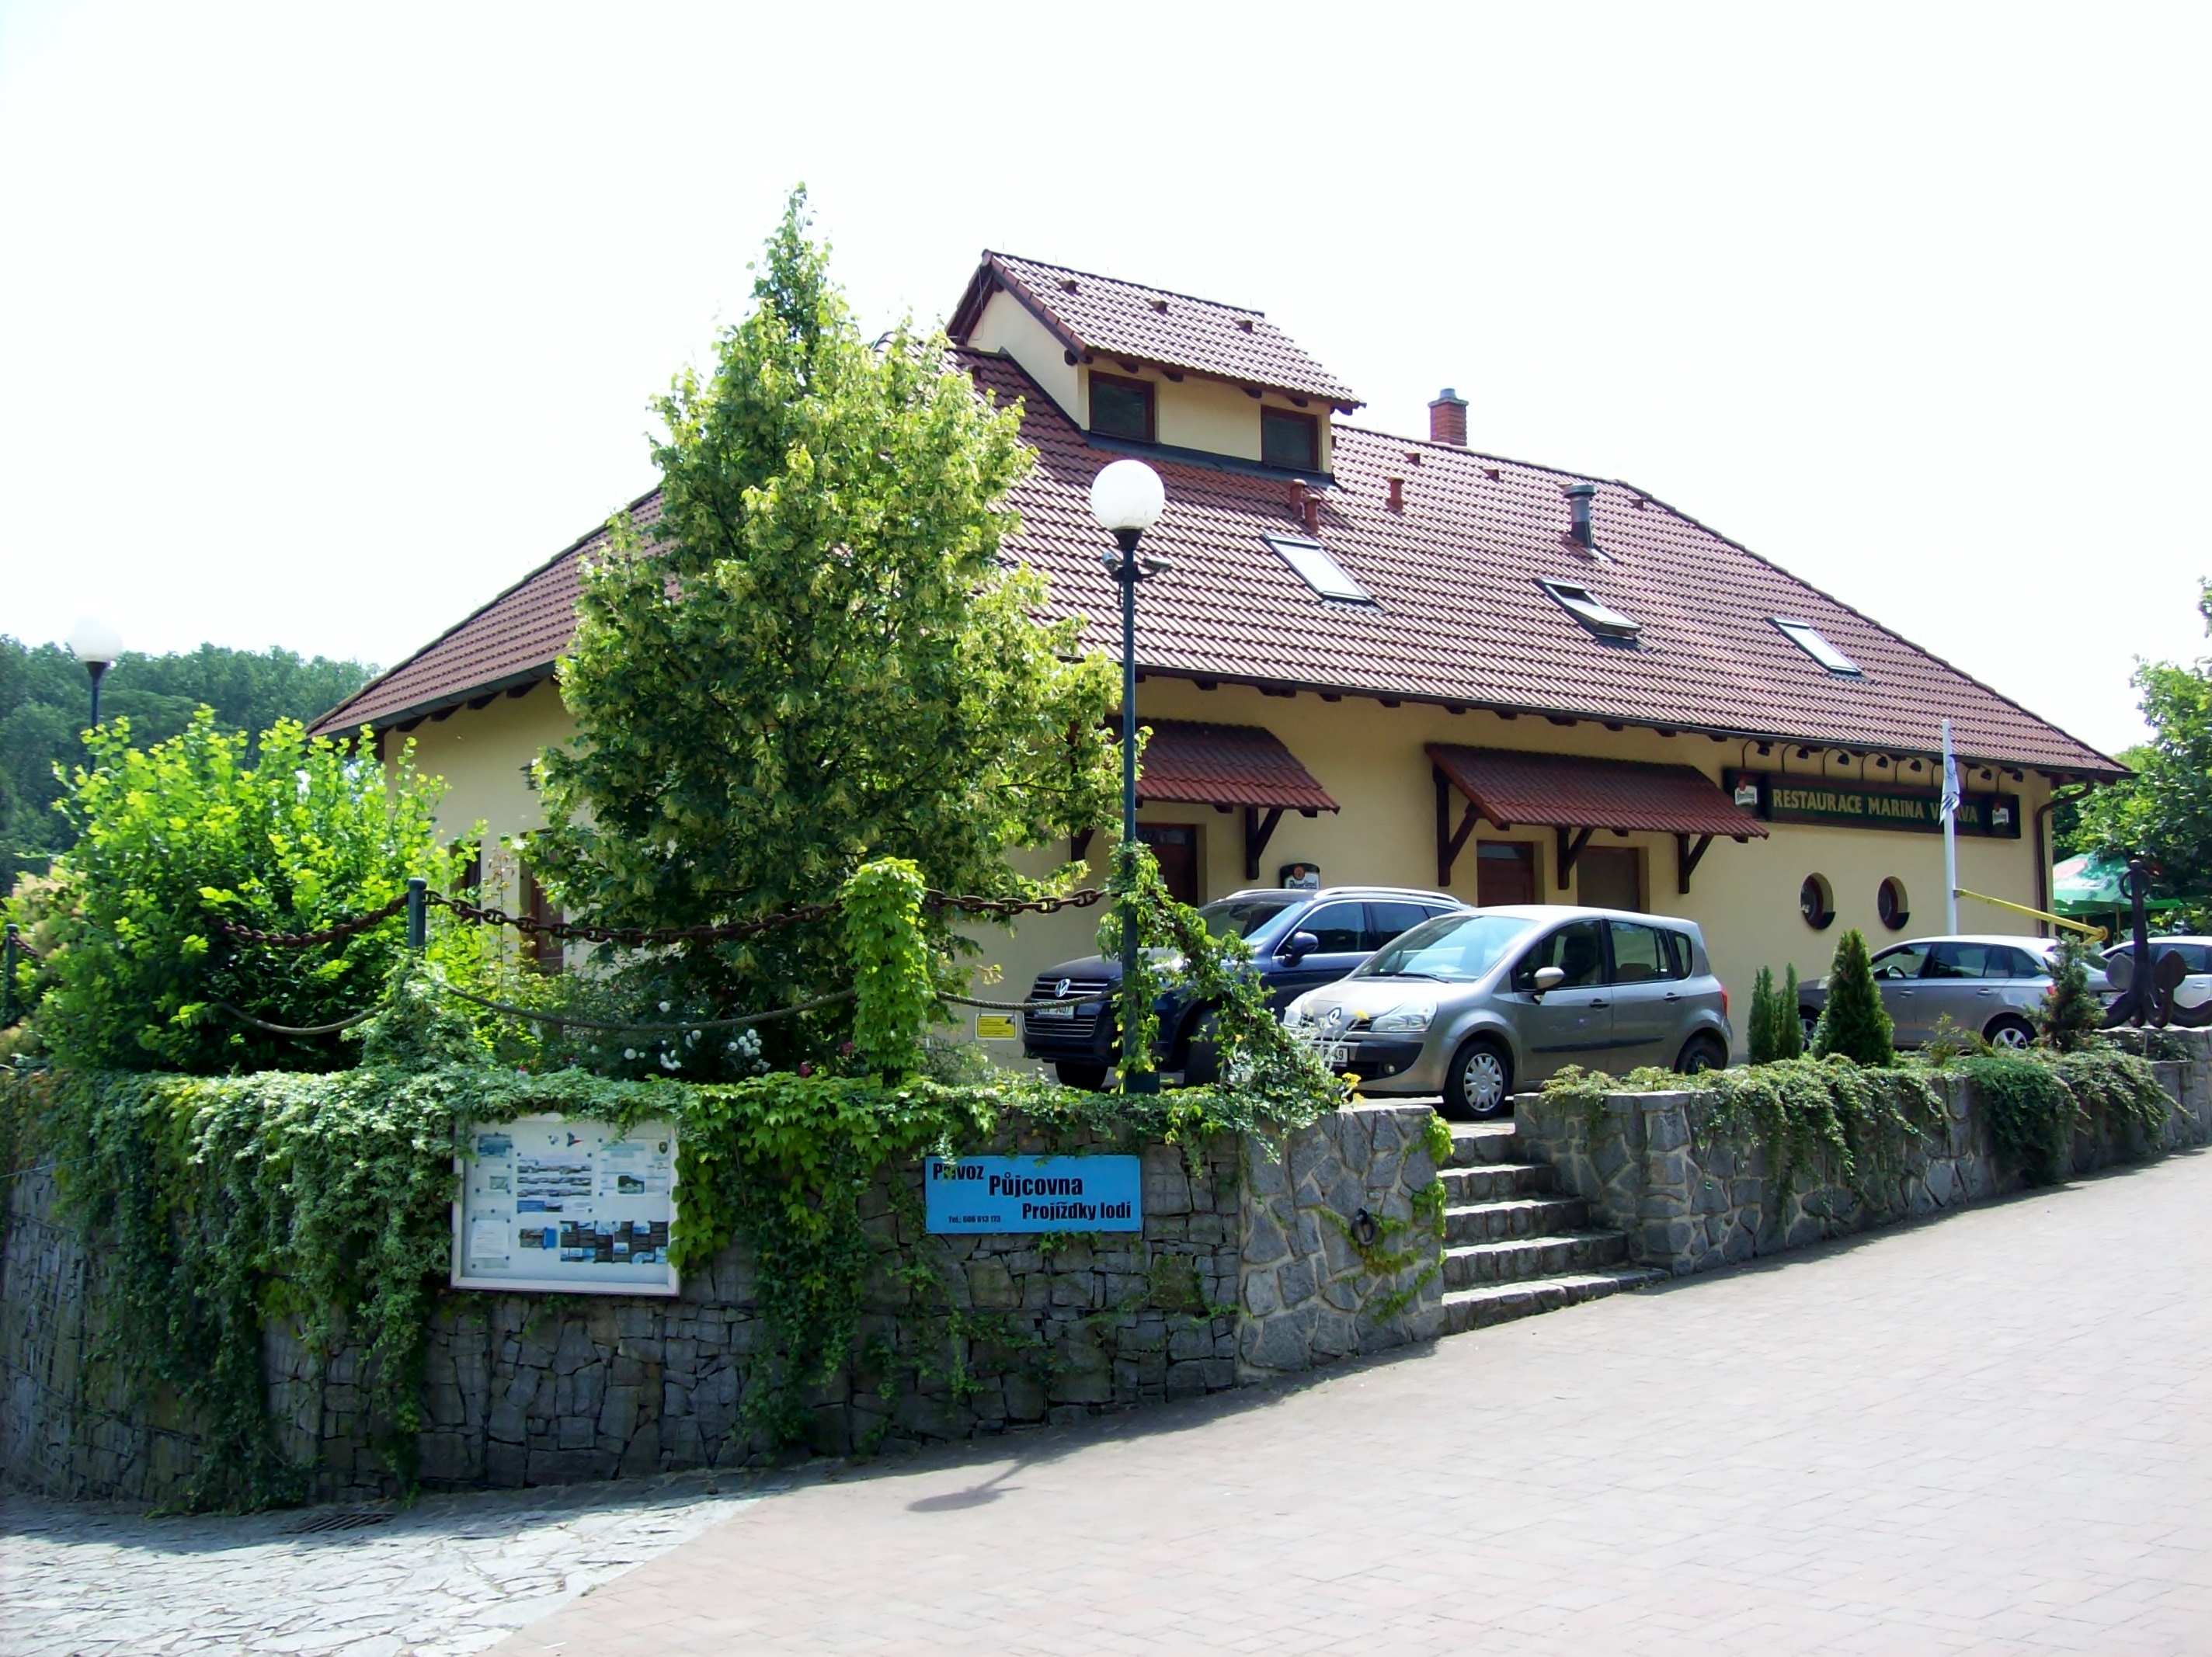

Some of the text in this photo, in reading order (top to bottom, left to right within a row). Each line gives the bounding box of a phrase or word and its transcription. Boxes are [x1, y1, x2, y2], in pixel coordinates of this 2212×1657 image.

[1772, 788, 1979, 823] RESTAURACE MARINA VAVA
[1100, 1201, 1132, 1219] lodí
